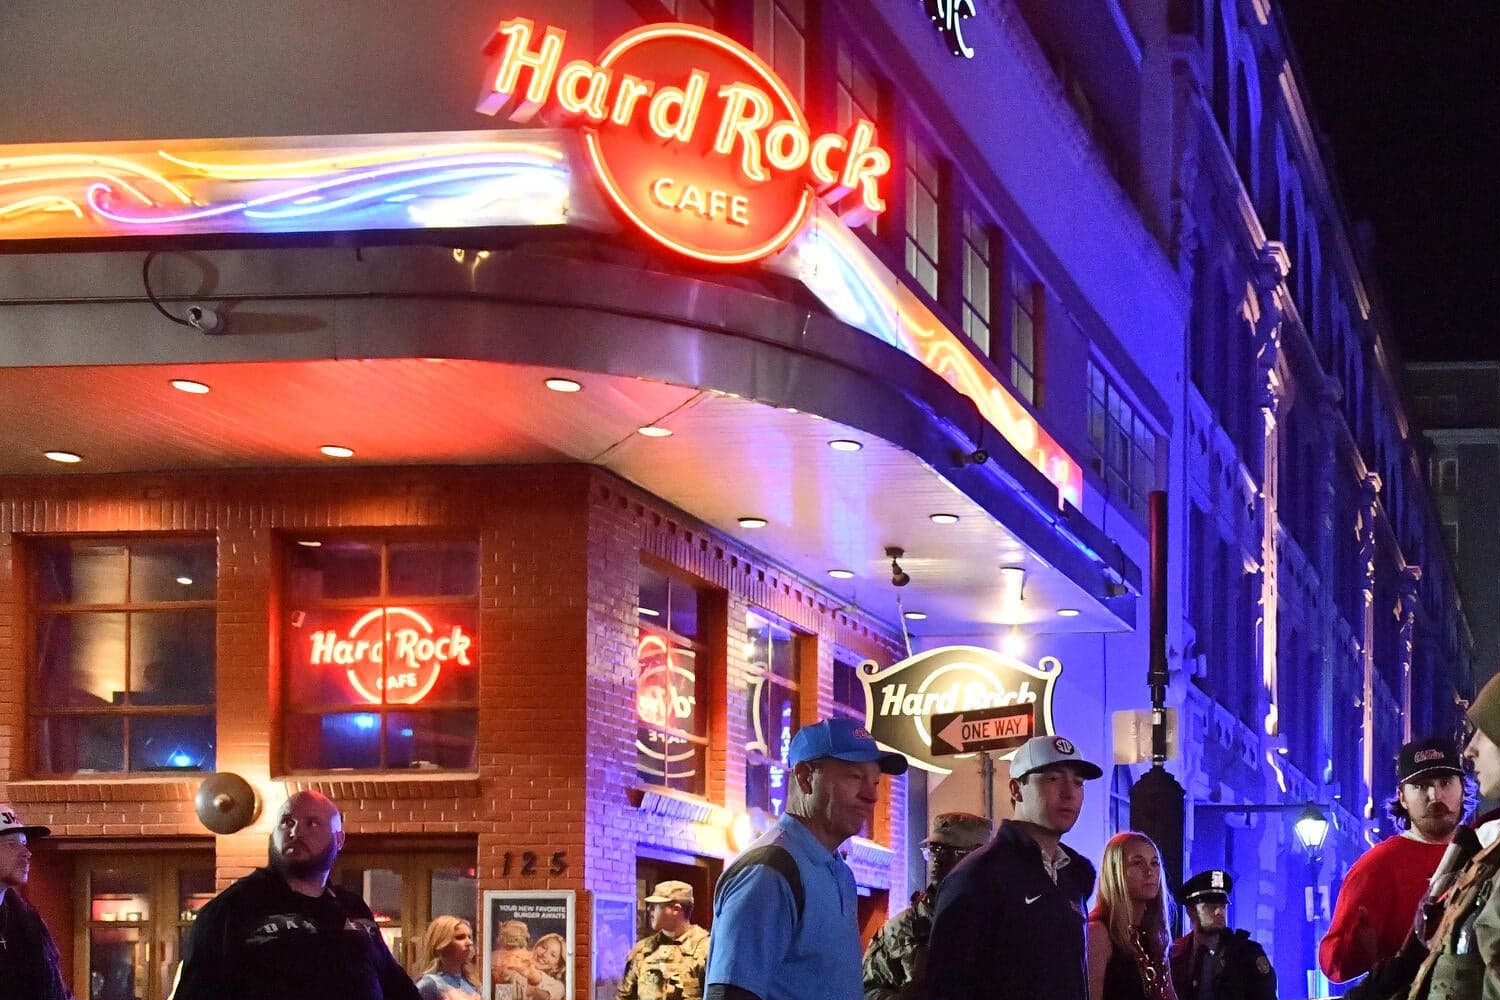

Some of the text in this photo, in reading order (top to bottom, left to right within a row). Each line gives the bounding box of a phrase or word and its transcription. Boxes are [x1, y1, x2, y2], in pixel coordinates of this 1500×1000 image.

[494, 16, 892, 213] Hard Rock
[652, 177, 750, 226] CAFE
[394, 625, 471, 669] Rock
[879, 683, 957, 716] Hard
[961, 718, 1023, 741] ONE WAY
[502, 851, 568, 877] 125
